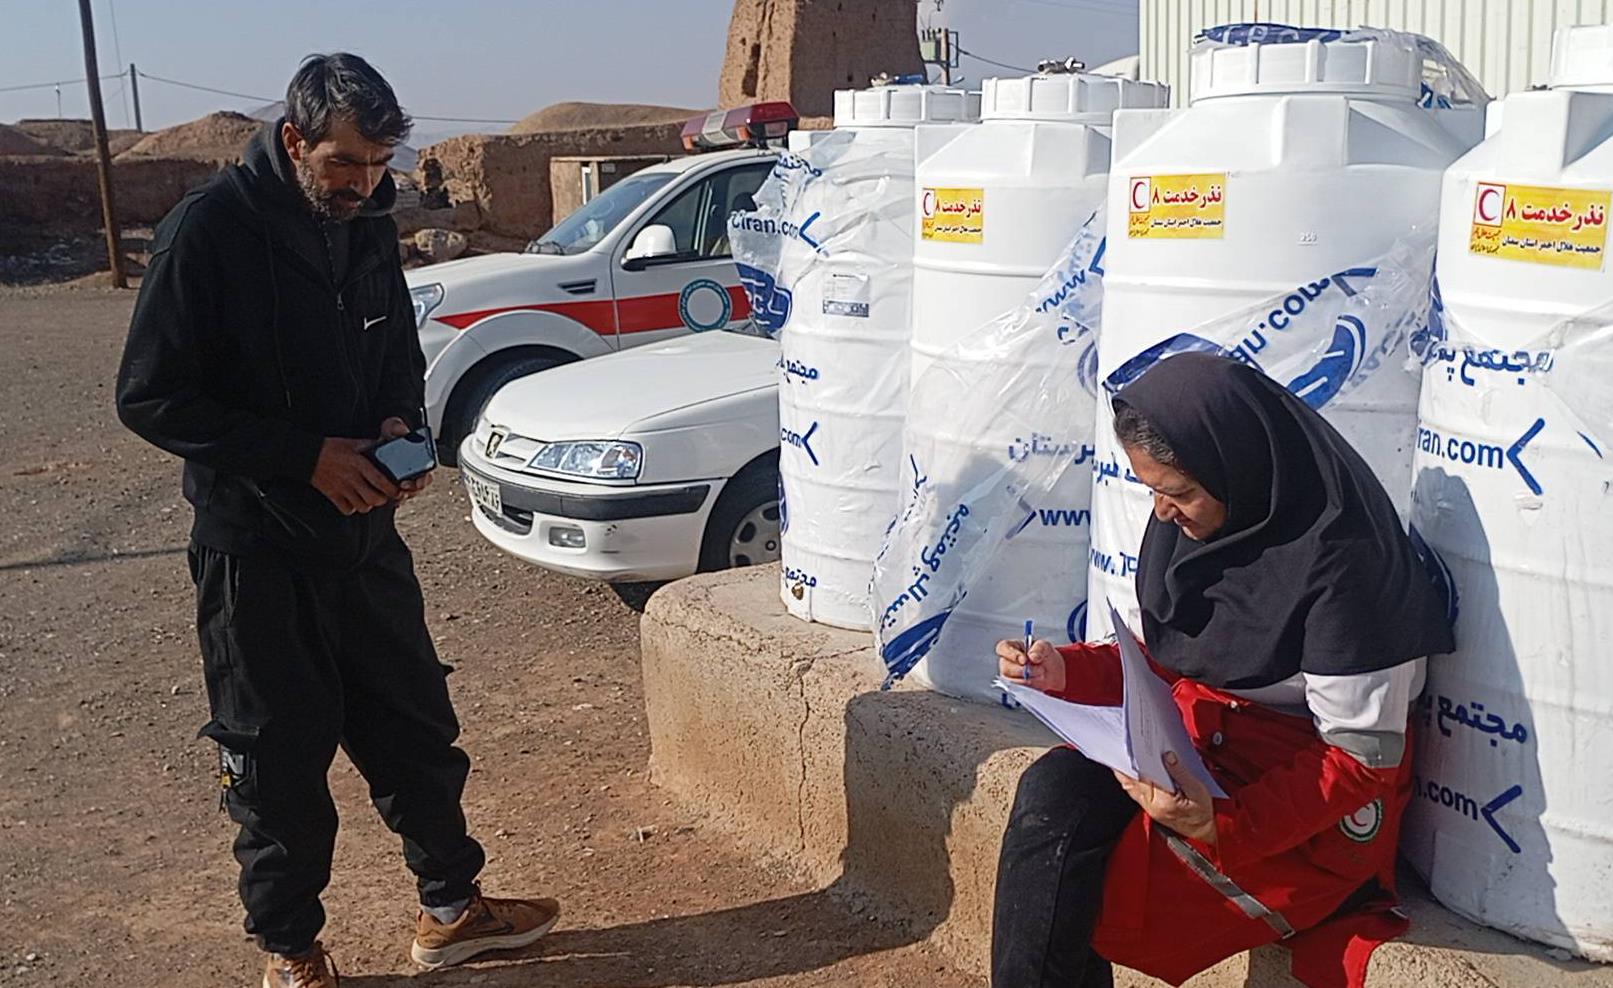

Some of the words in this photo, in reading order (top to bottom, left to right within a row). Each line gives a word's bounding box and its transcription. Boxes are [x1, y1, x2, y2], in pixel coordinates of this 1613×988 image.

[1163, 187, 1199, 204] خدمت
[1200, 186, 1222, 208] نذر
[942, 199, 966, 213] خدمت
[966, 199, 982, 218] نذر
[1521, 203, 1572, 222] خدمت
[1571, 204, 1604, 230] نذر
[1556, 241, 1573, 253] هلال
[1417, 427, 1504, 469] ran.com
[1437, 695, 1528, 748] مجتمع
